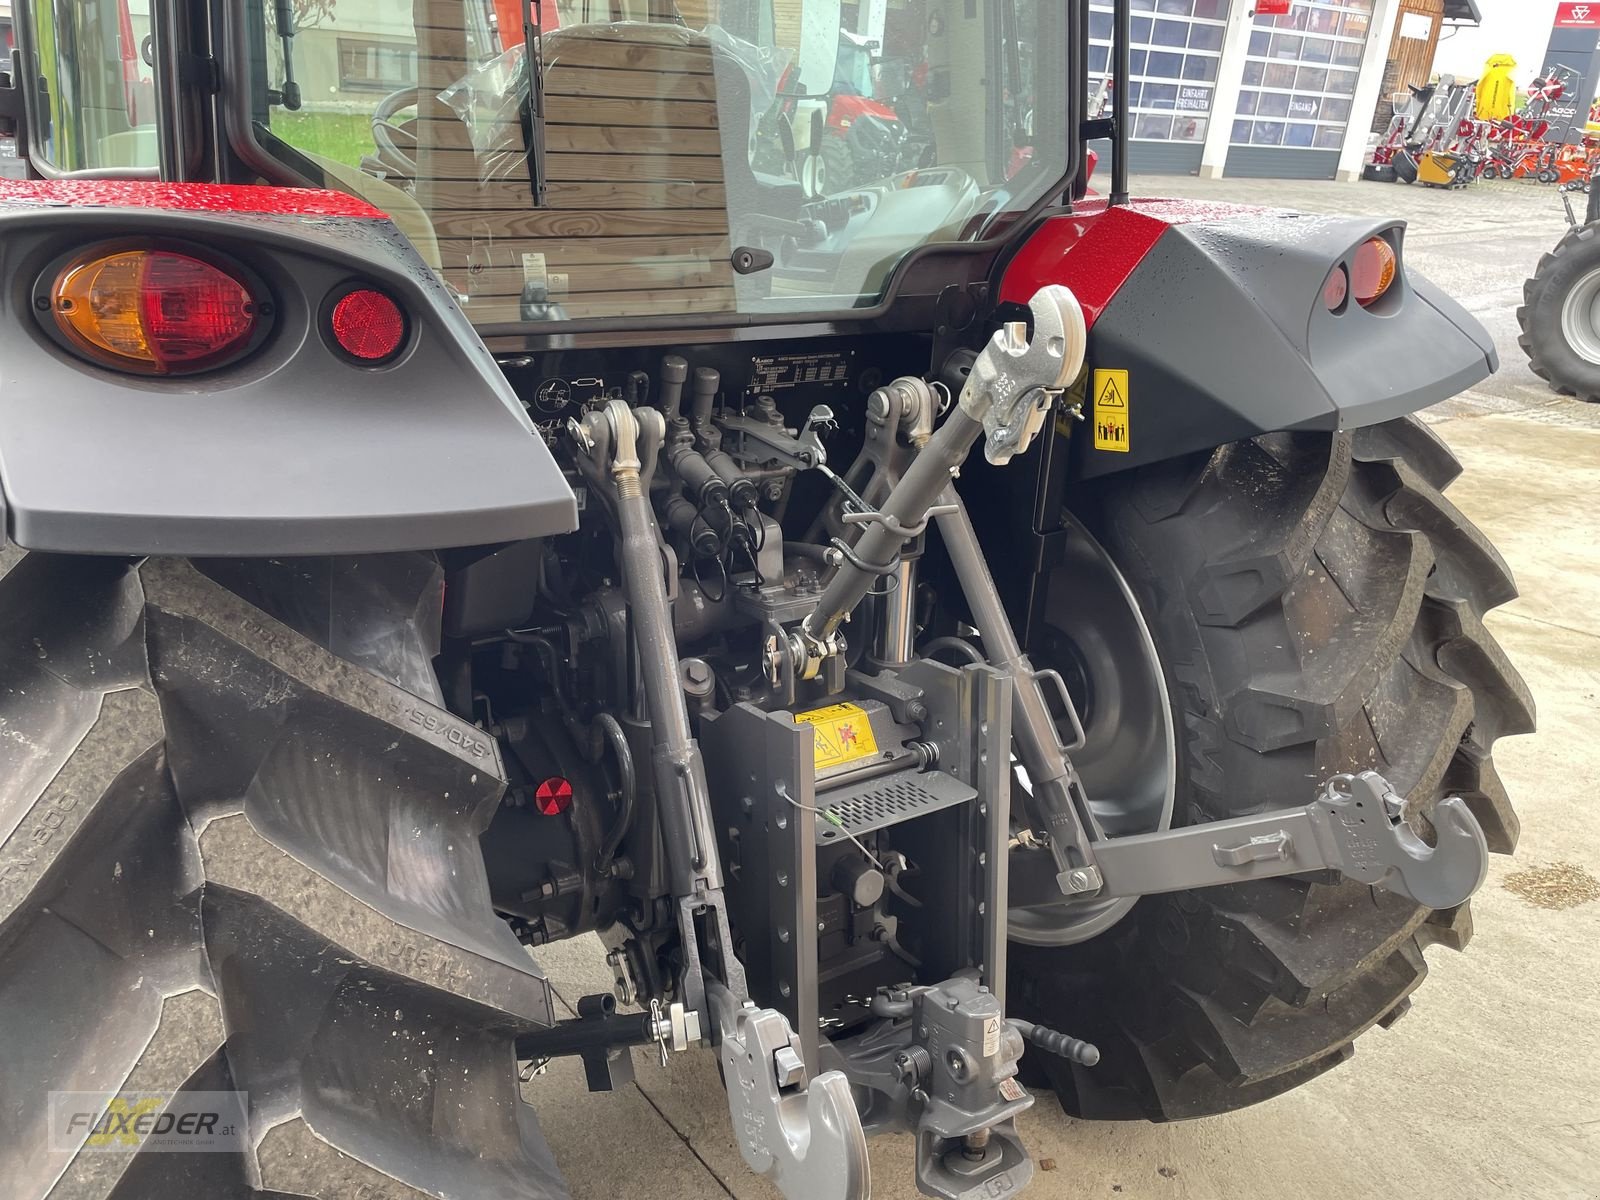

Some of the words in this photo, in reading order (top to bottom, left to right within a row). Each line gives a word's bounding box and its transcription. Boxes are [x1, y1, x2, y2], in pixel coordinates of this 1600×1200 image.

[1182, 87, 1209, 99] EINFAHRT
[1177, 98, 1209, 110] FREIHALTEN
[1290, 101, 1312, 112] EINGANG
